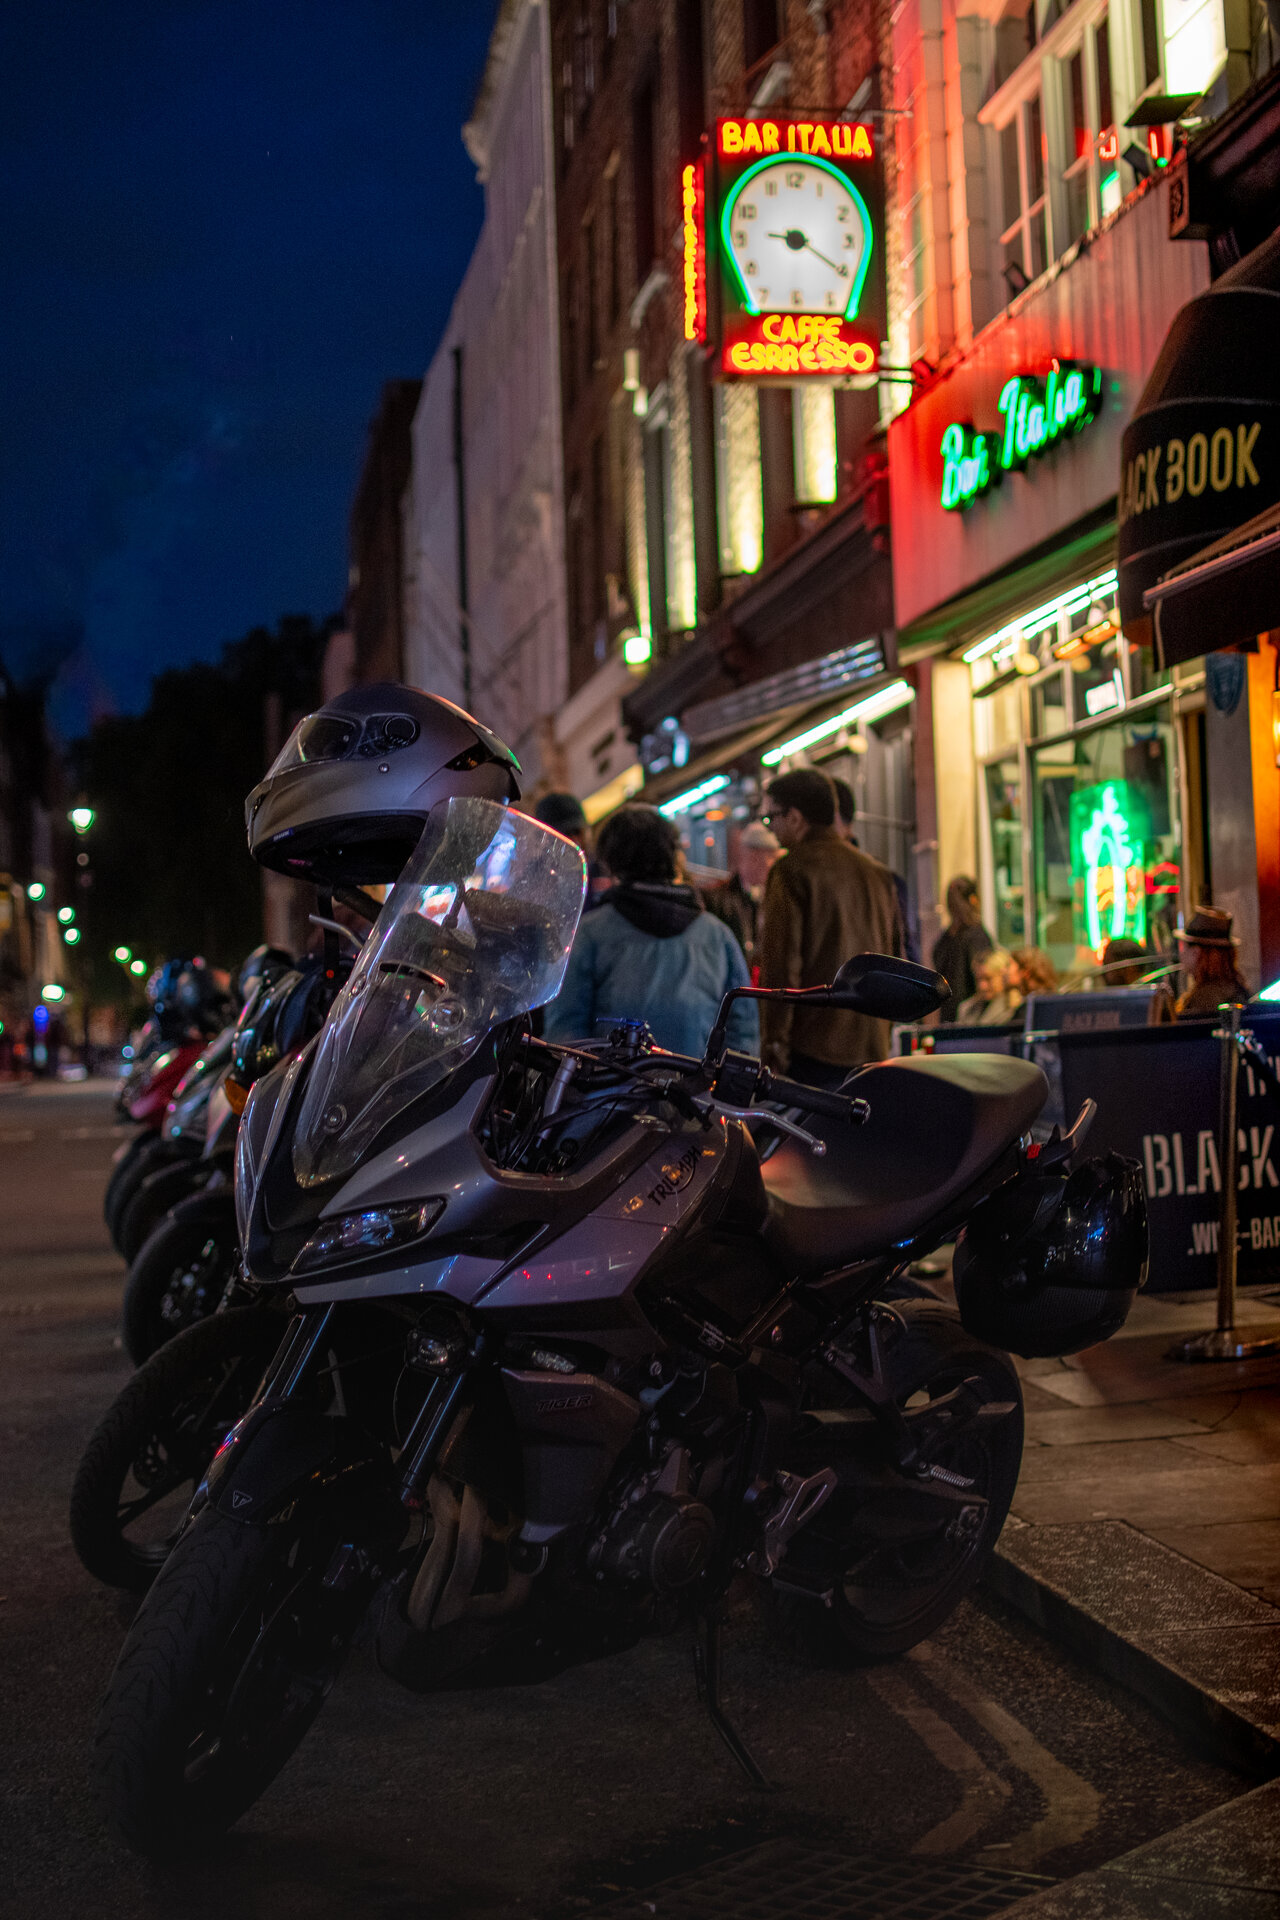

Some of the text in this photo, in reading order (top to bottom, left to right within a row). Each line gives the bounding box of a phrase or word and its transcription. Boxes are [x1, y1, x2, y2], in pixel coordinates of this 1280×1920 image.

[721, 121, 873, 157] BAR ITALIA
[785, 171, 805, 189] 12
[837, 205, 849, 222] 2
[761, 314, 843, 344] CAFFE
[940, 366, 1094, 510] Bar Italia
[1165, 421, 1262, 504] BOOK
[647, 1145, 702, 1206] TRIUMPH
[535, 1394, 592, 1413] TIGER
